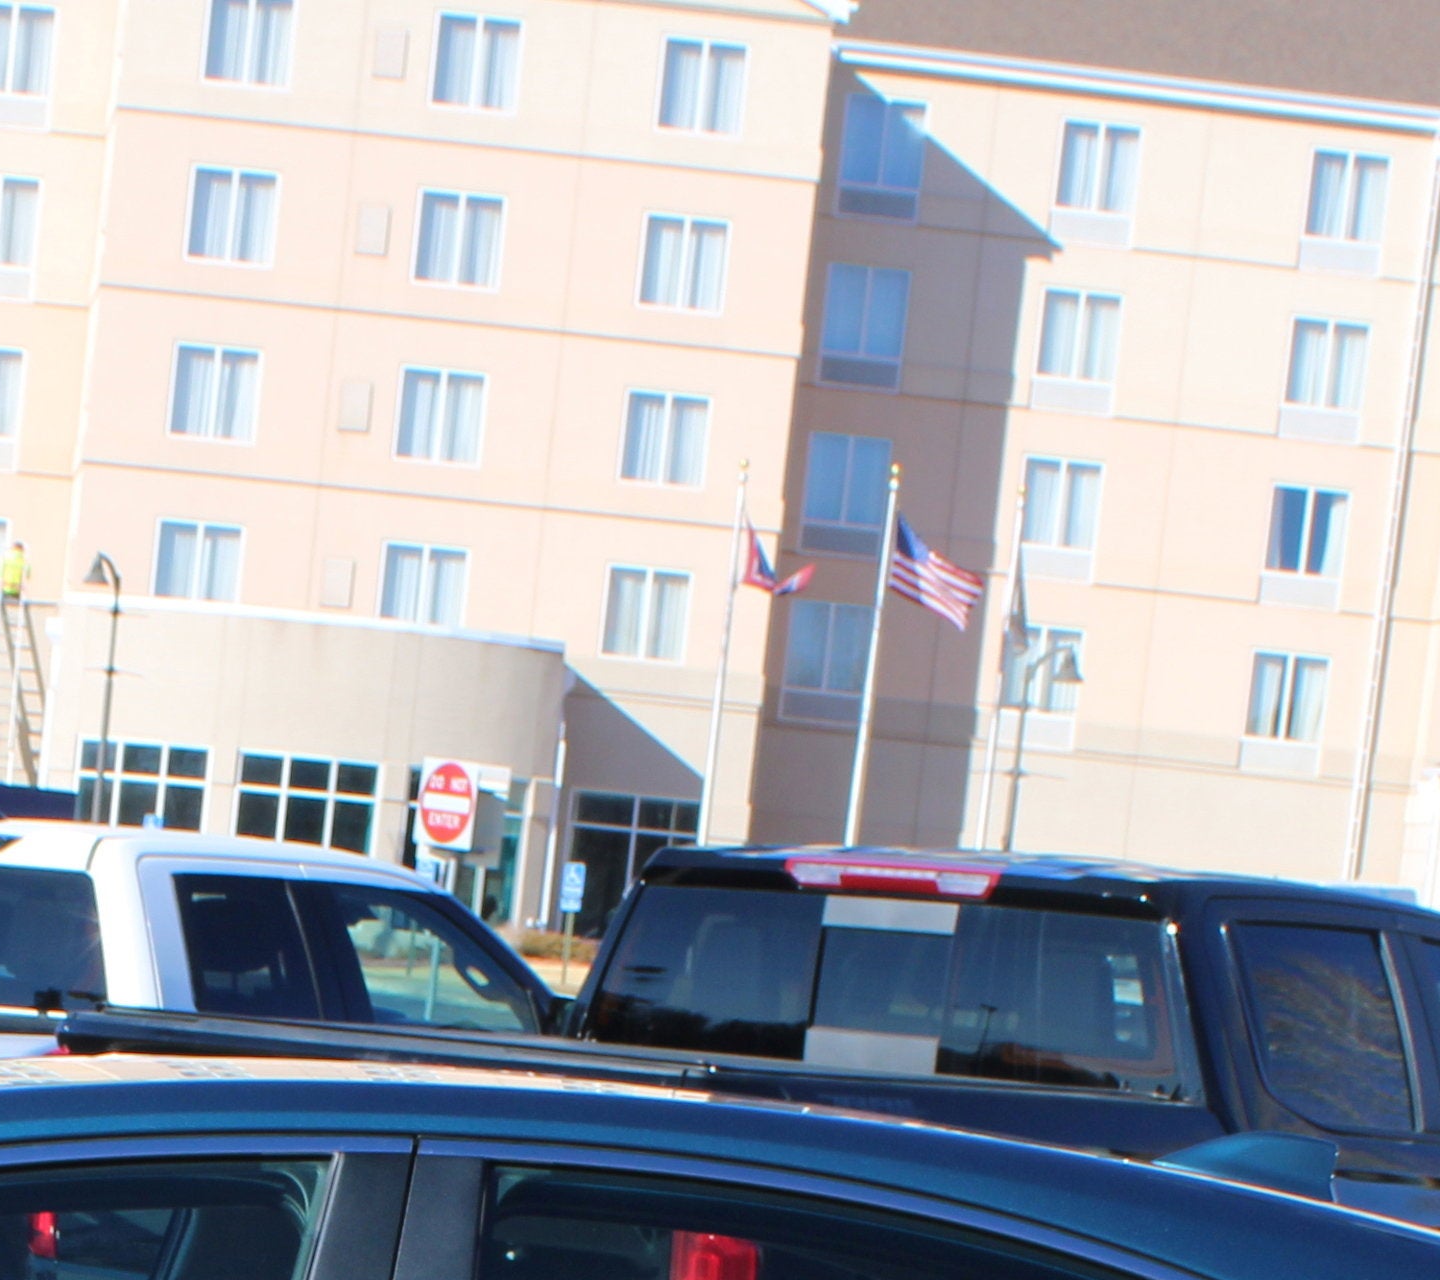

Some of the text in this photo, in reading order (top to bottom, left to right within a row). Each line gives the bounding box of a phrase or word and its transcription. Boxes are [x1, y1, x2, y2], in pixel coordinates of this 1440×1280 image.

[429, 774, 469, 792] DO NOT
[428, 811, 461, 830] ENTER
